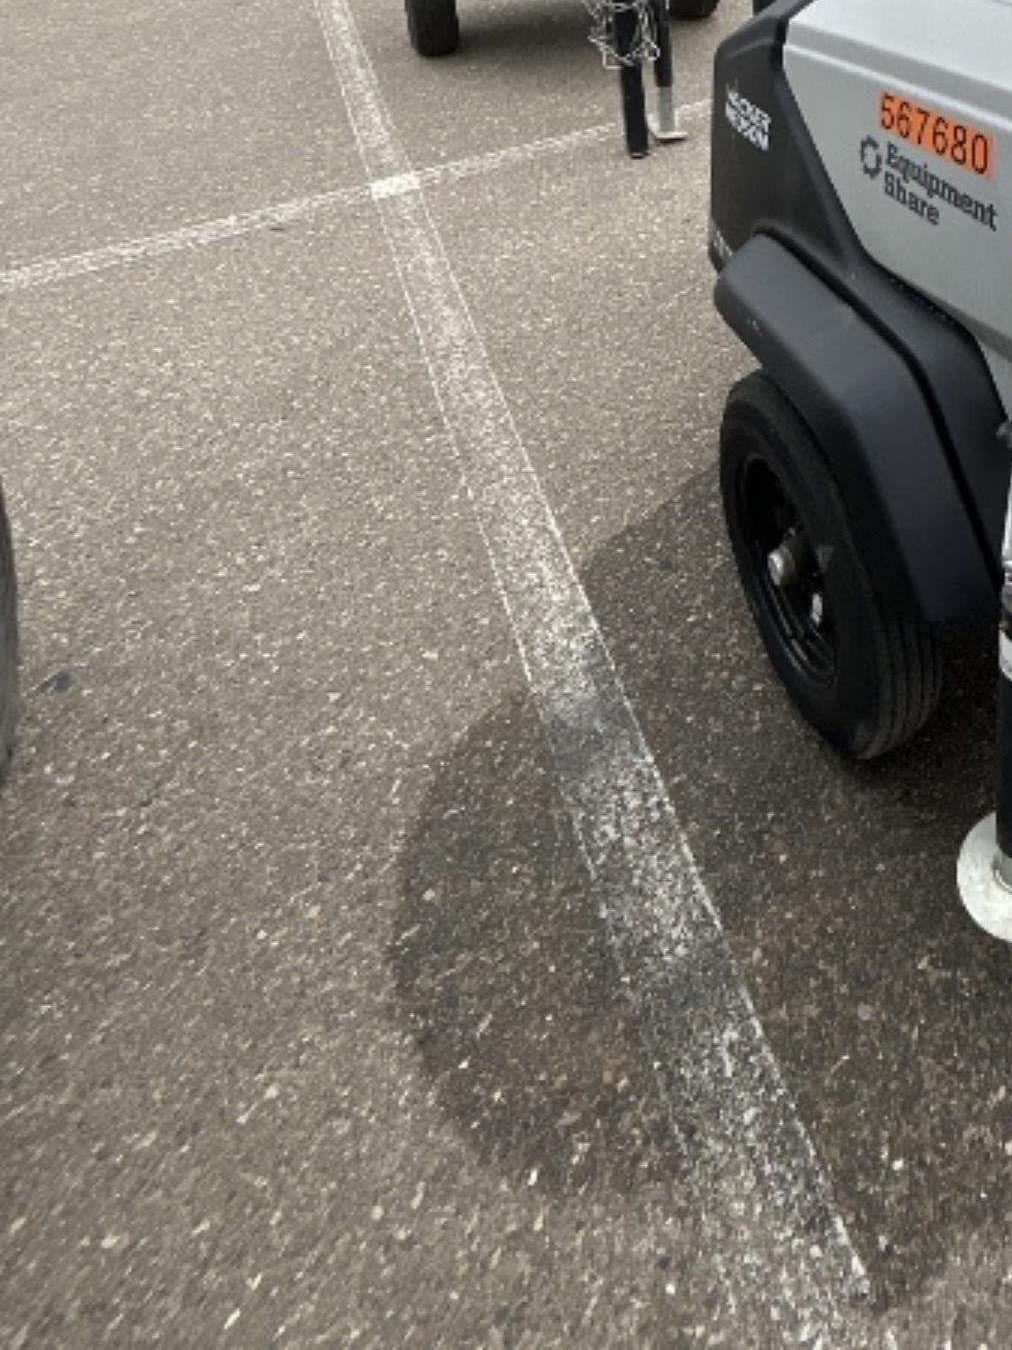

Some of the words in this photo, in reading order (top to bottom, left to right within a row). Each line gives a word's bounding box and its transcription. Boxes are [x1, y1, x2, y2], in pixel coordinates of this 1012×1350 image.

[881, 92, 988, 175] 567680
[884, 170, 941, 226] Share
[885, 141, 999, 232] Equipment
